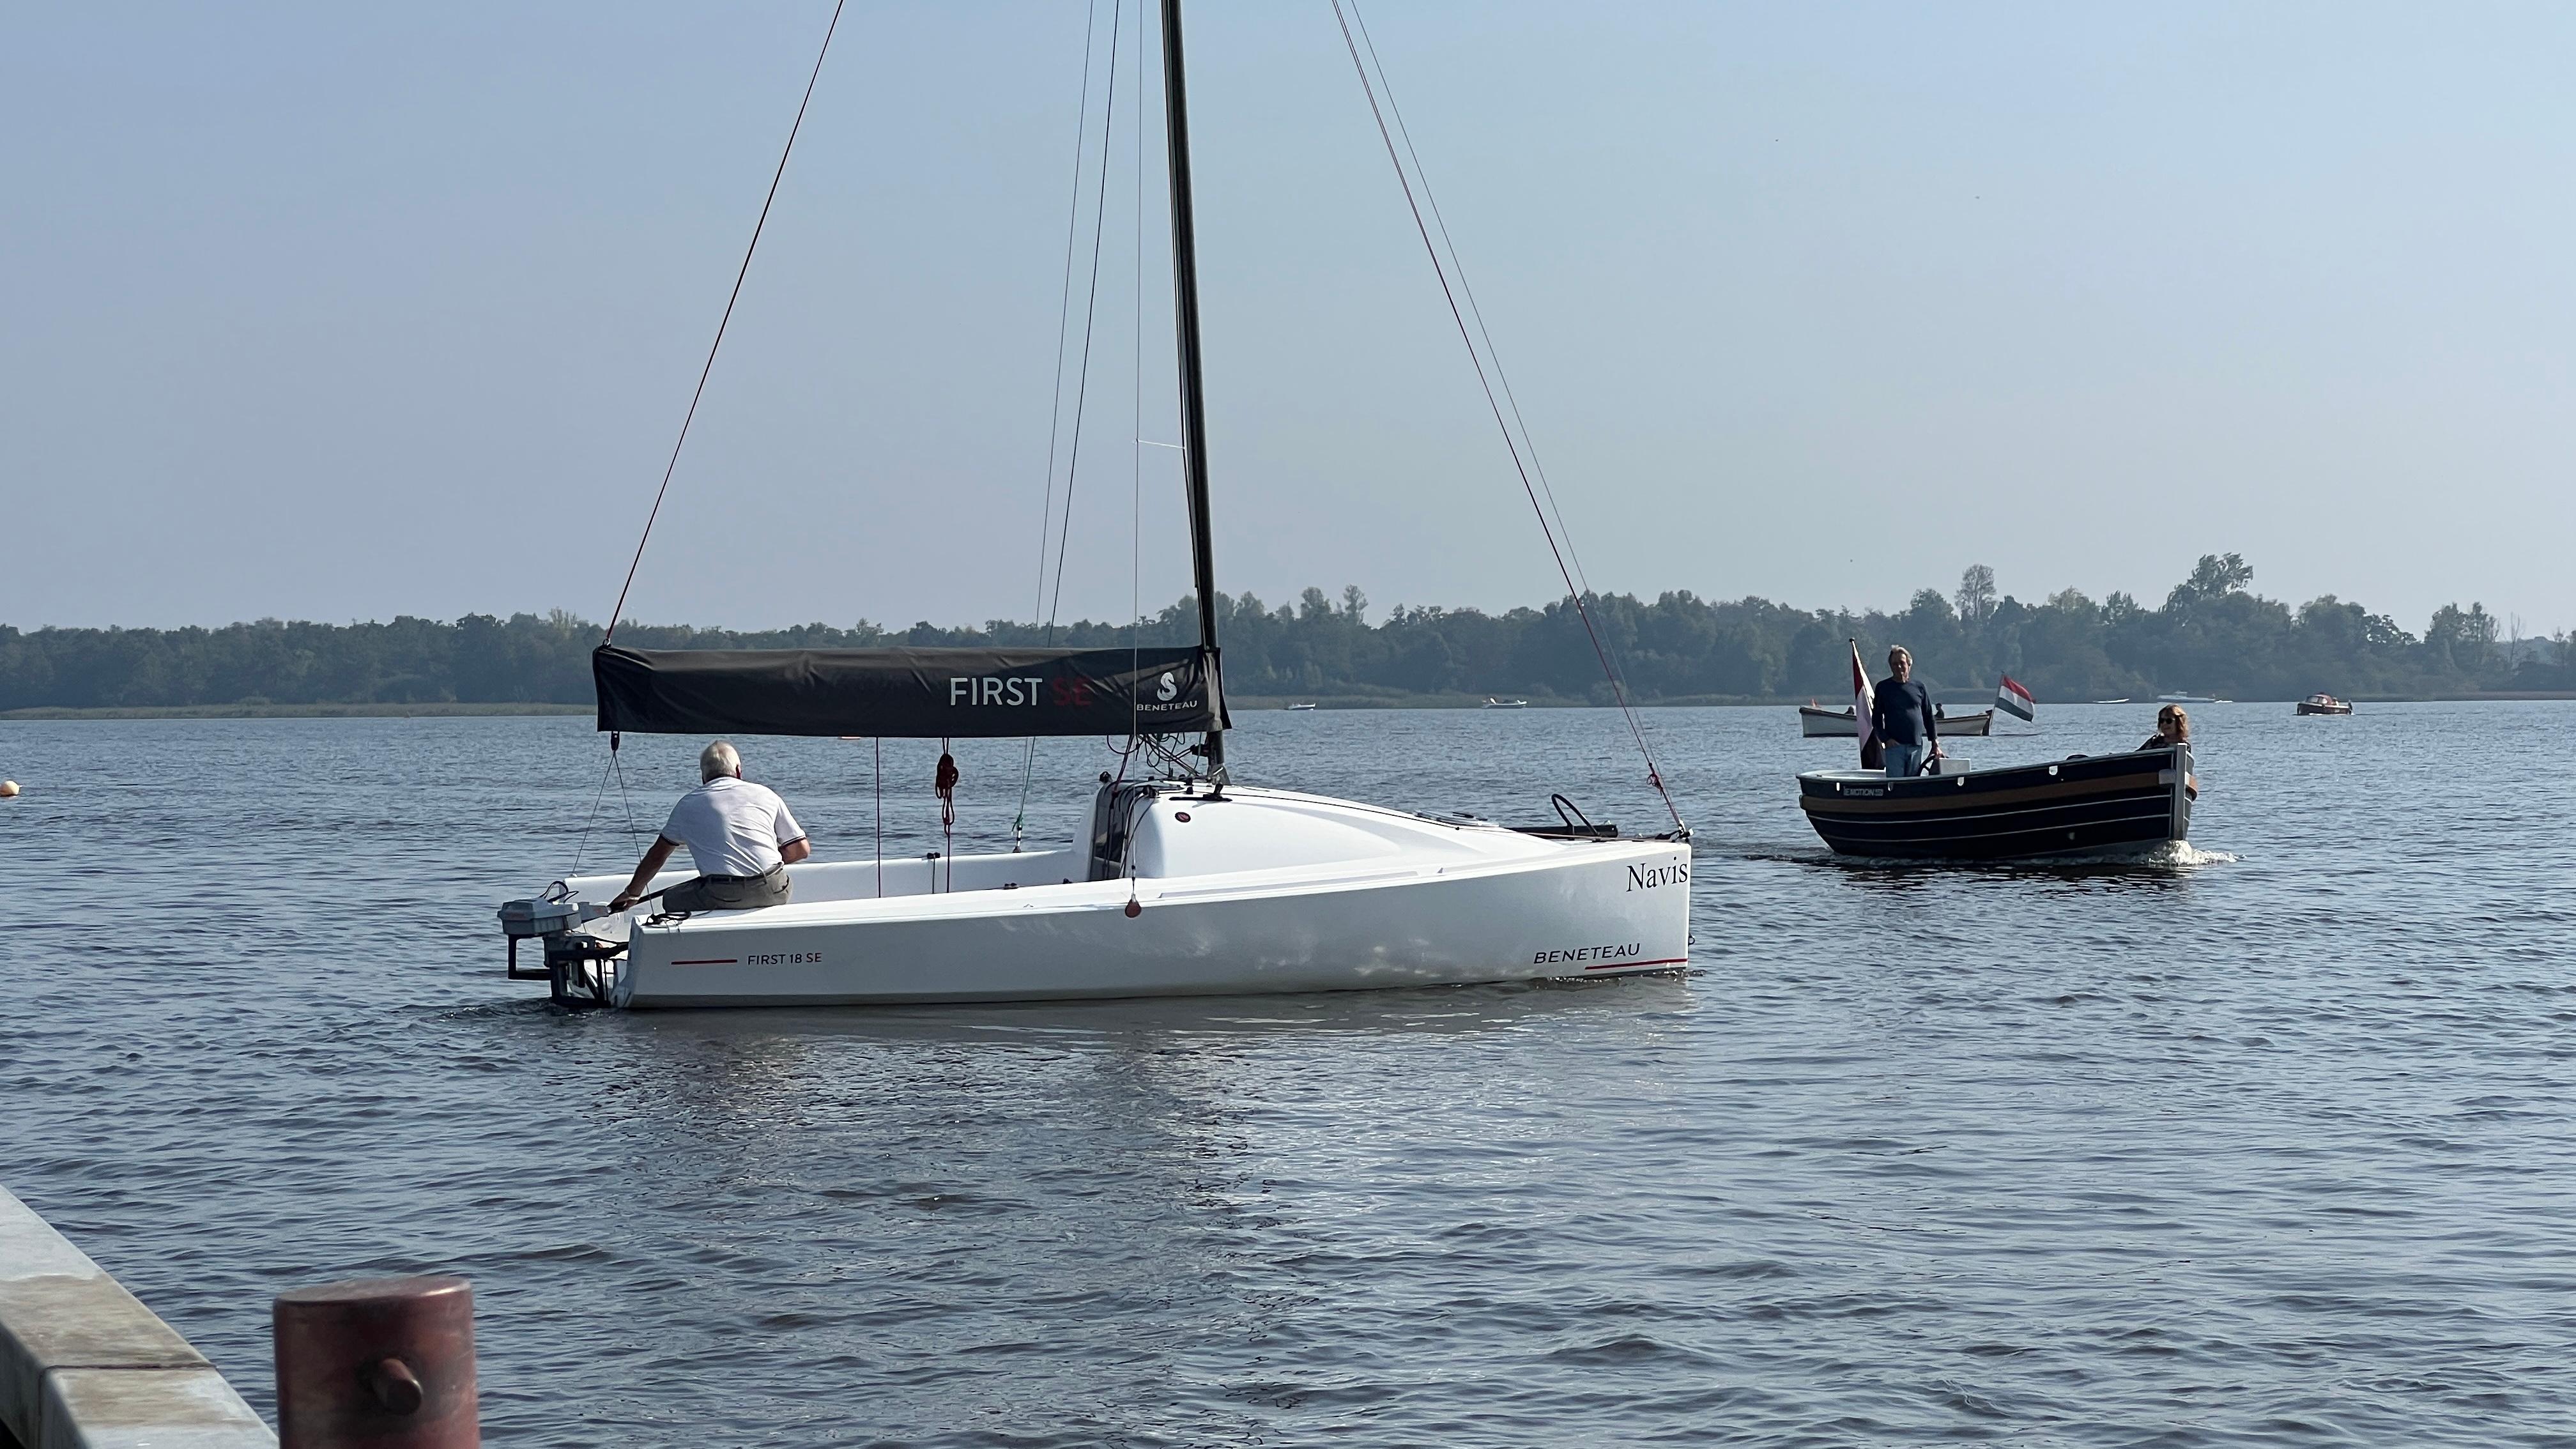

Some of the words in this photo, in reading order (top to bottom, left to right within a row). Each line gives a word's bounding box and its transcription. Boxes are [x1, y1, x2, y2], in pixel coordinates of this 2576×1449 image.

[950, 677, 1042, 705] FIRST
[1052, 676, 1092, 705] SE
[1137, 700, 1197, 710] BENETEAU
[1626, 857, 1687, 892] Navis
[747, 954, 786, 965] FIRST
[790, 953, 802, 963] 18
[806, 953, 822, 963] SE
[1533, 943, 1639, 964] BENETEAU
